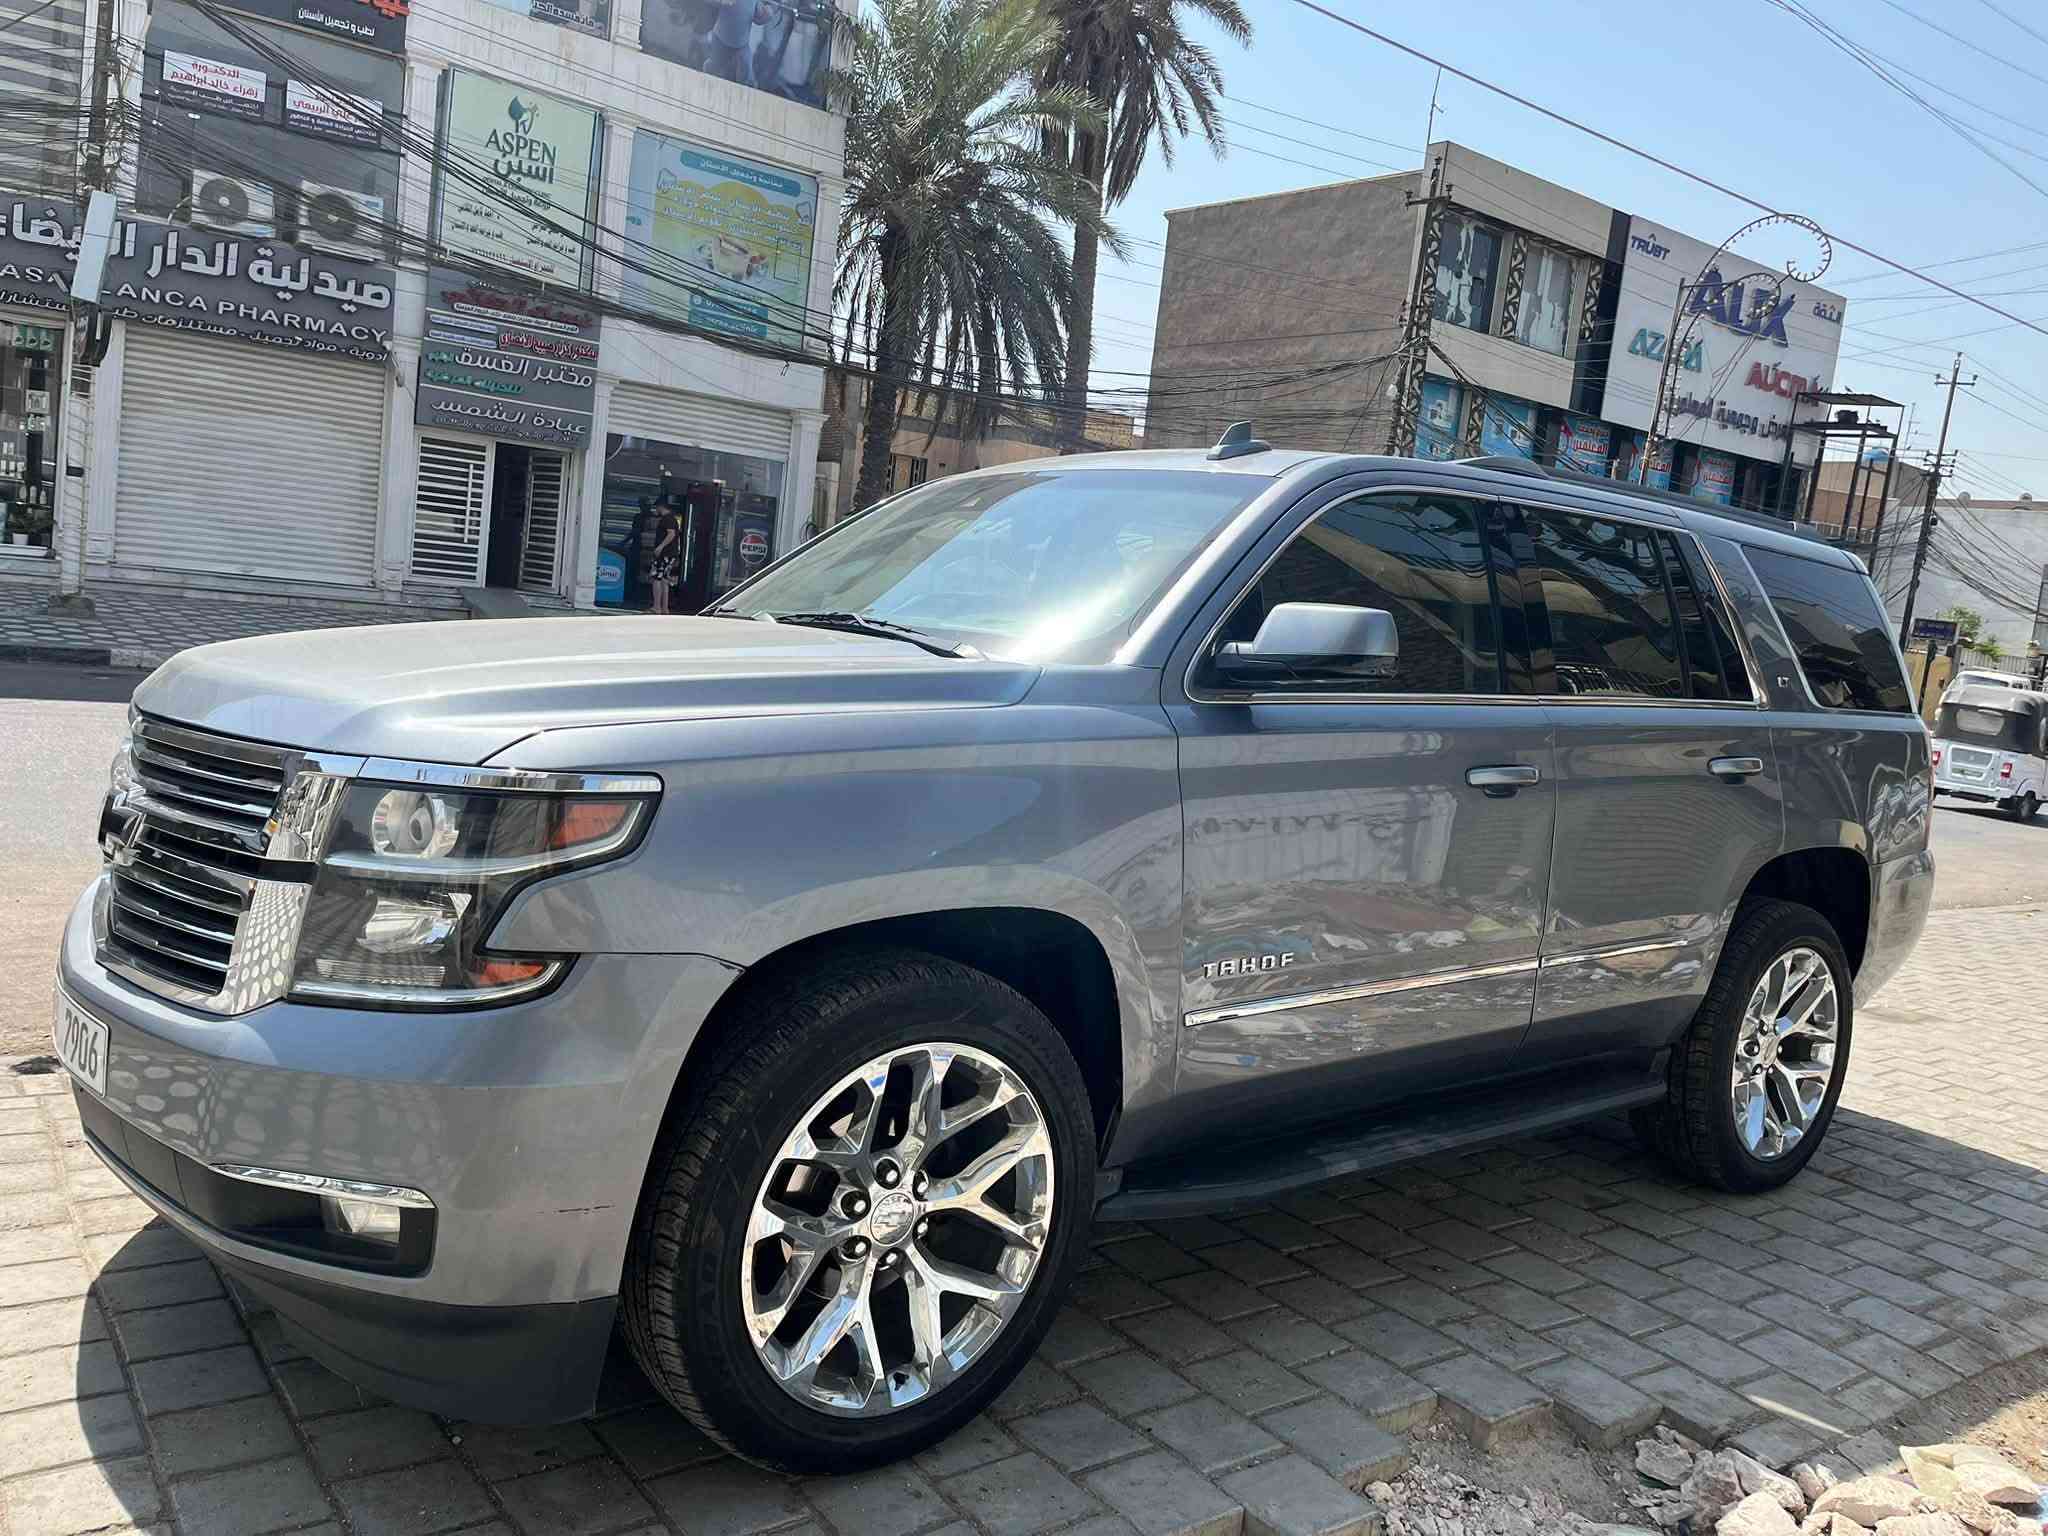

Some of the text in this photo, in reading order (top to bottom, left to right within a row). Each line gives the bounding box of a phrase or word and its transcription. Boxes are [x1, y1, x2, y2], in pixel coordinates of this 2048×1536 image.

[485, 128, 557, 167] ASPEN
[145, 230, 240, 279] الدار
[248, 245, 394, 313] صيدلية
[218, 298, 388, 344] PHARMACY
[453, 345, 530, 376] الغسق
[532, 366, 594, 388] مختبر
[533, 412, 587, 437] عيادة
[63, 1007, 98, 1080] 7906
